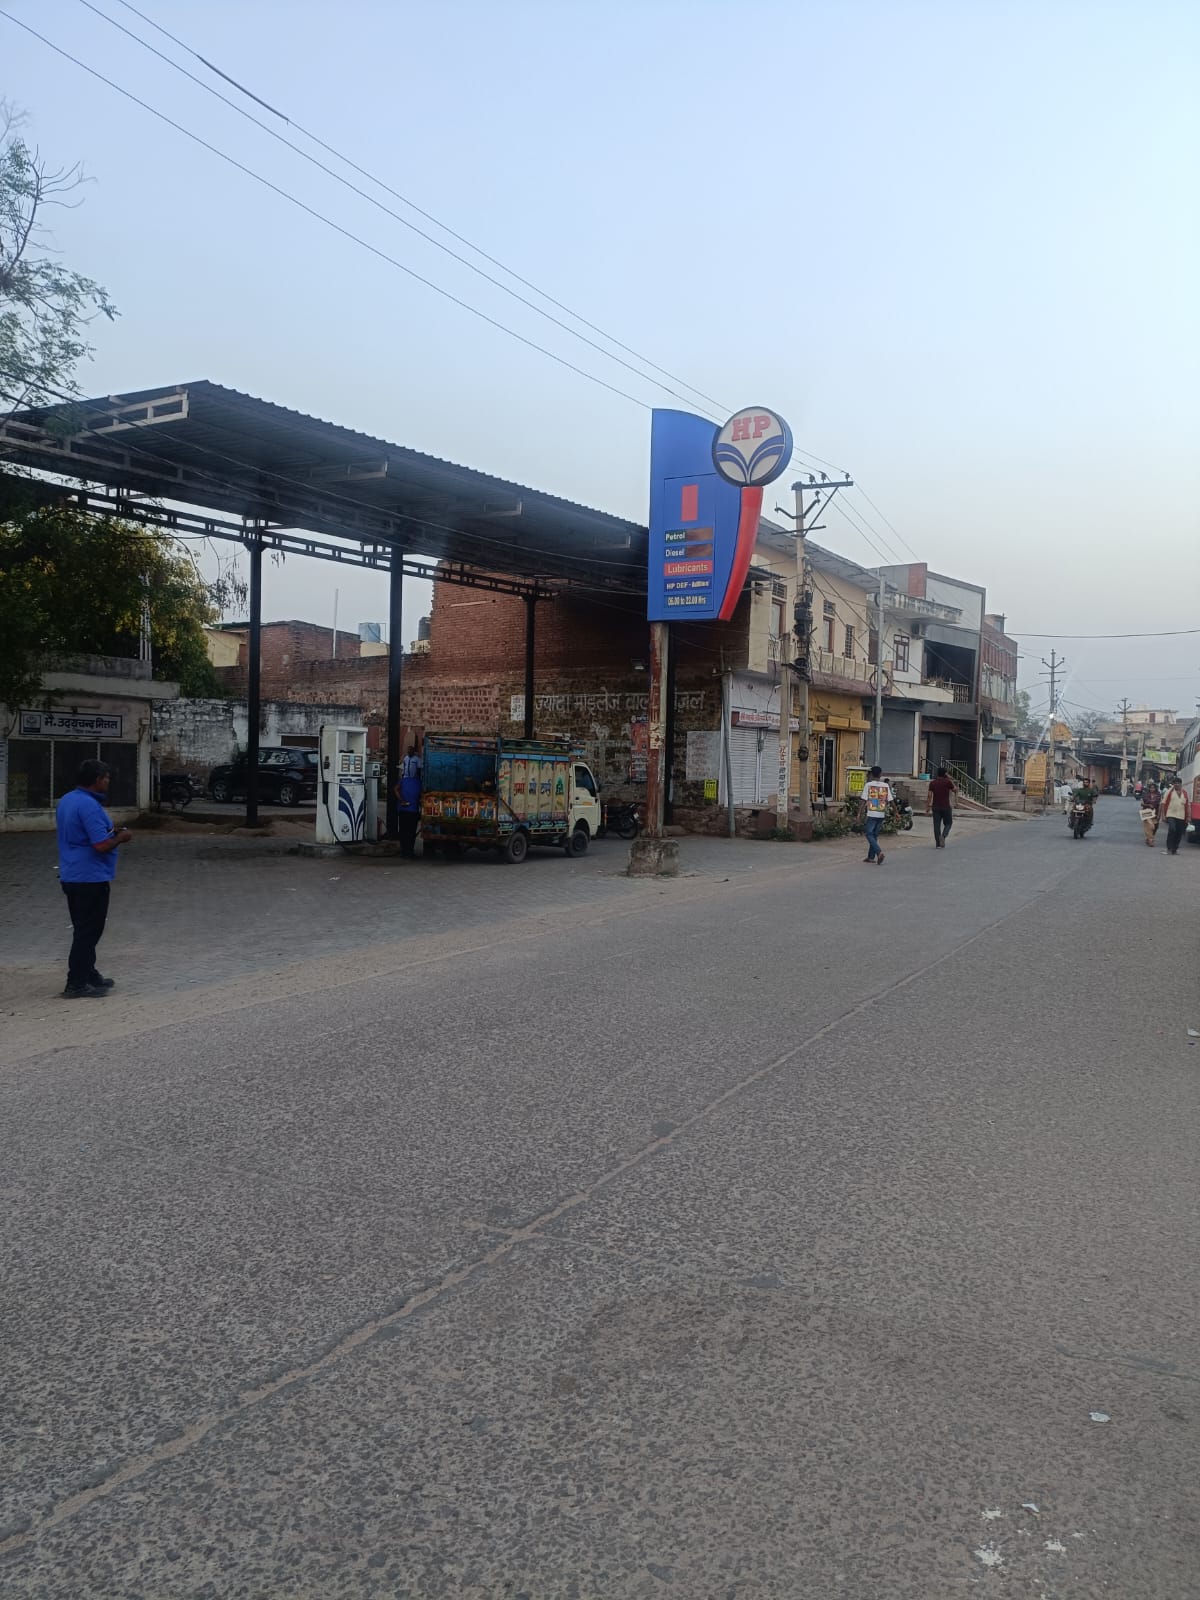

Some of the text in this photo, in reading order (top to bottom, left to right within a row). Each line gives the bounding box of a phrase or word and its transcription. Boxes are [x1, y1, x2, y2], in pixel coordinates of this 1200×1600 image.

[731, 415, 771, 442] HP
[665, 531, 686, 541] Petrol
[665, 548, 685, 557] Diesel
[667, 562, 708, 574] Lubricants
